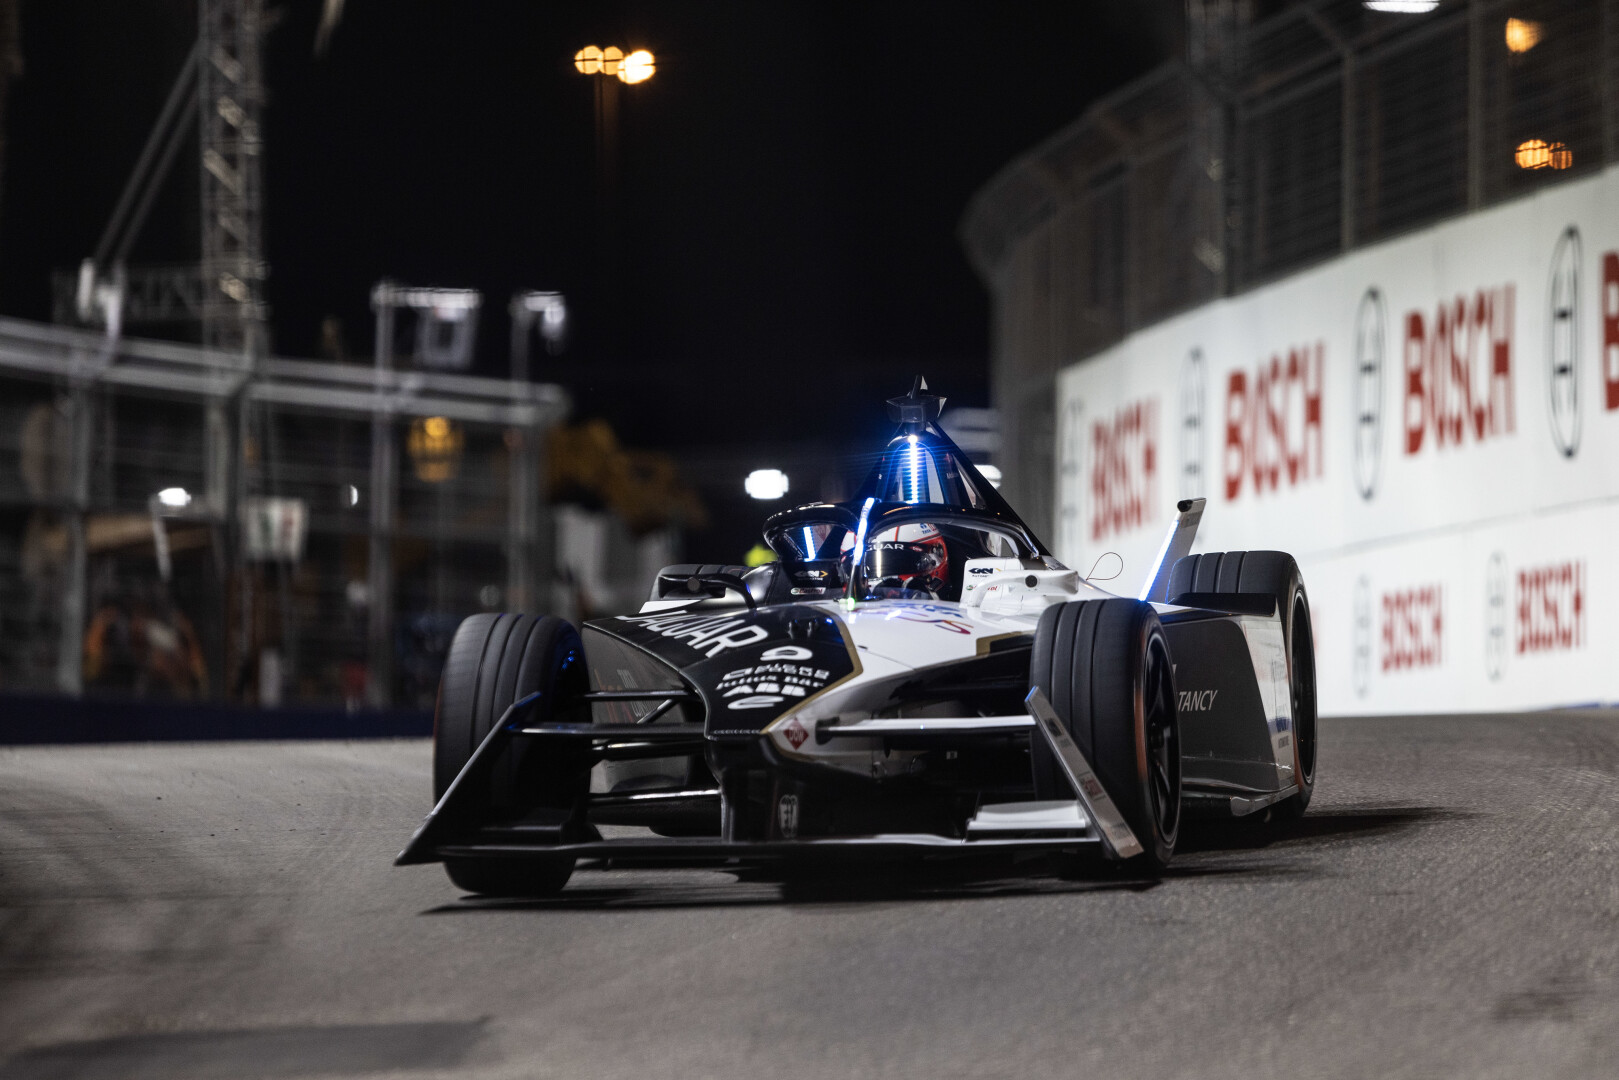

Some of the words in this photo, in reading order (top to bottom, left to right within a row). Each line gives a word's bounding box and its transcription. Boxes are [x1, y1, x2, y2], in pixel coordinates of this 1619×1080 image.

[1404, 286, 1517, 456] BOSCH
[1224, 344, 1325, 502] BOSCH
[1092, 401, 1160, 541] BOSCH
[614, 610, 768, 658] JAGUAR
[1382, 586, 1443, 671] BOSCH
[1517, 561, 1586, 655] BOSCH
[1177, 690, 1218, 711] TANCY
